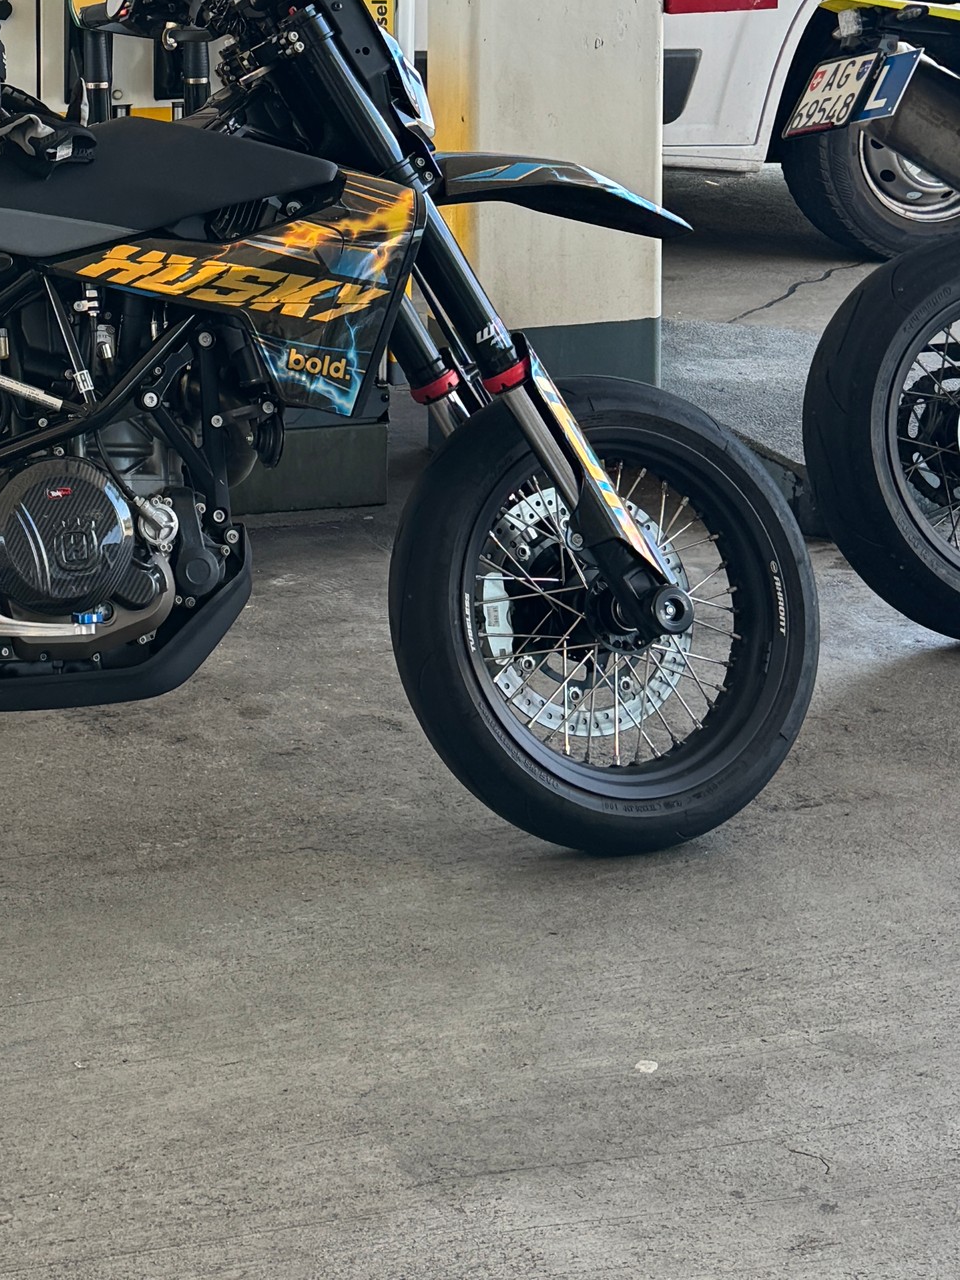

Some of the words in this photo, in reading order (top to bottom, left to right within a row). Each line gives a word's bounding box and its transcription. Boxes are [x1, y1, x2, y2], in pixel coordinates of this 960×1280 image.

[822, 60, 856, 93] AG
[864, 65, 891, 111] L
[790, 92, 856, 130] 69548
[76, 244, 391, 322] HUSKY
[287, 348, 352, 381] bold.
